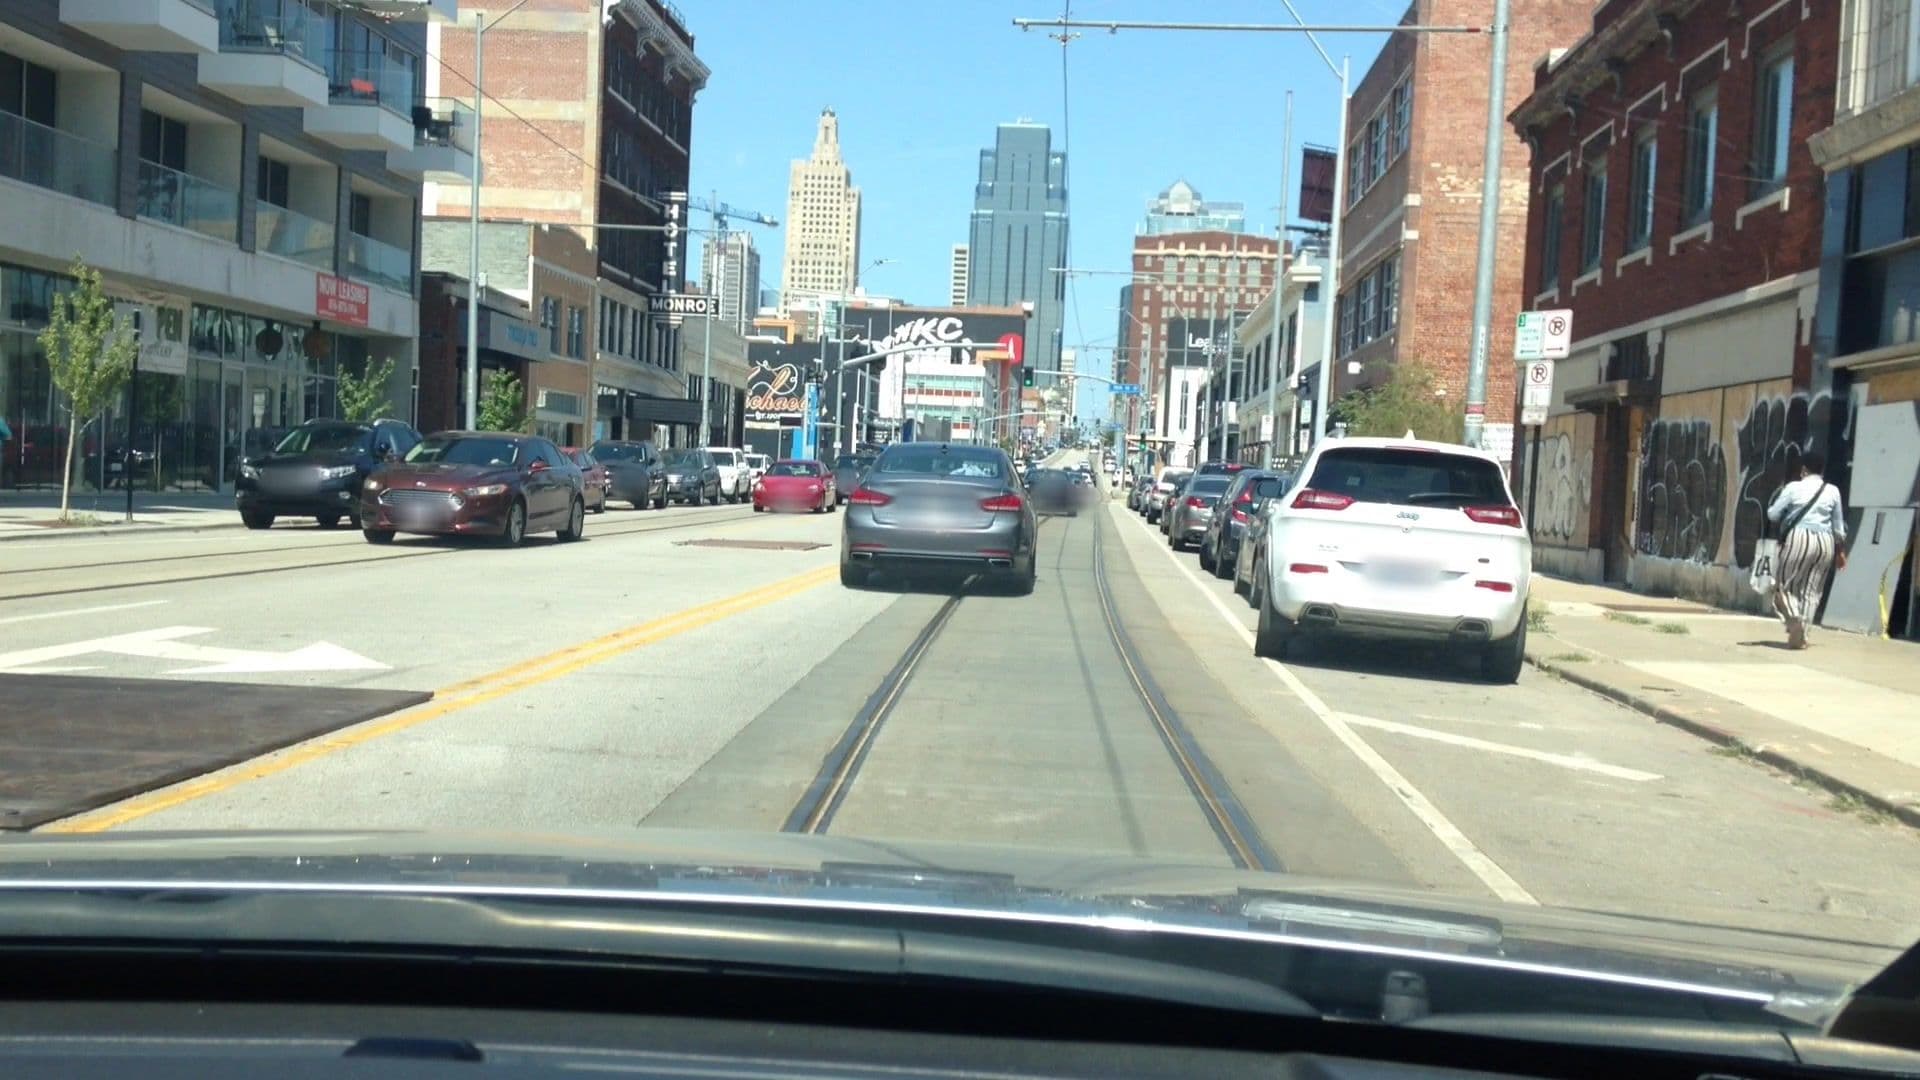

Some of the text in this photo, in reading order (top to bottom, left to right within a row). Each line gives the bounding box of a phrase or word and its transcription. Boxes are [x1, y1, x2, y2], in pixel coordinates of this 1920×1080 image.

[662, 203, 679, 294] HOTEL
[320, 275, 367, 304] NOW LEASING
[651, 298, 716, 312] MONROE
